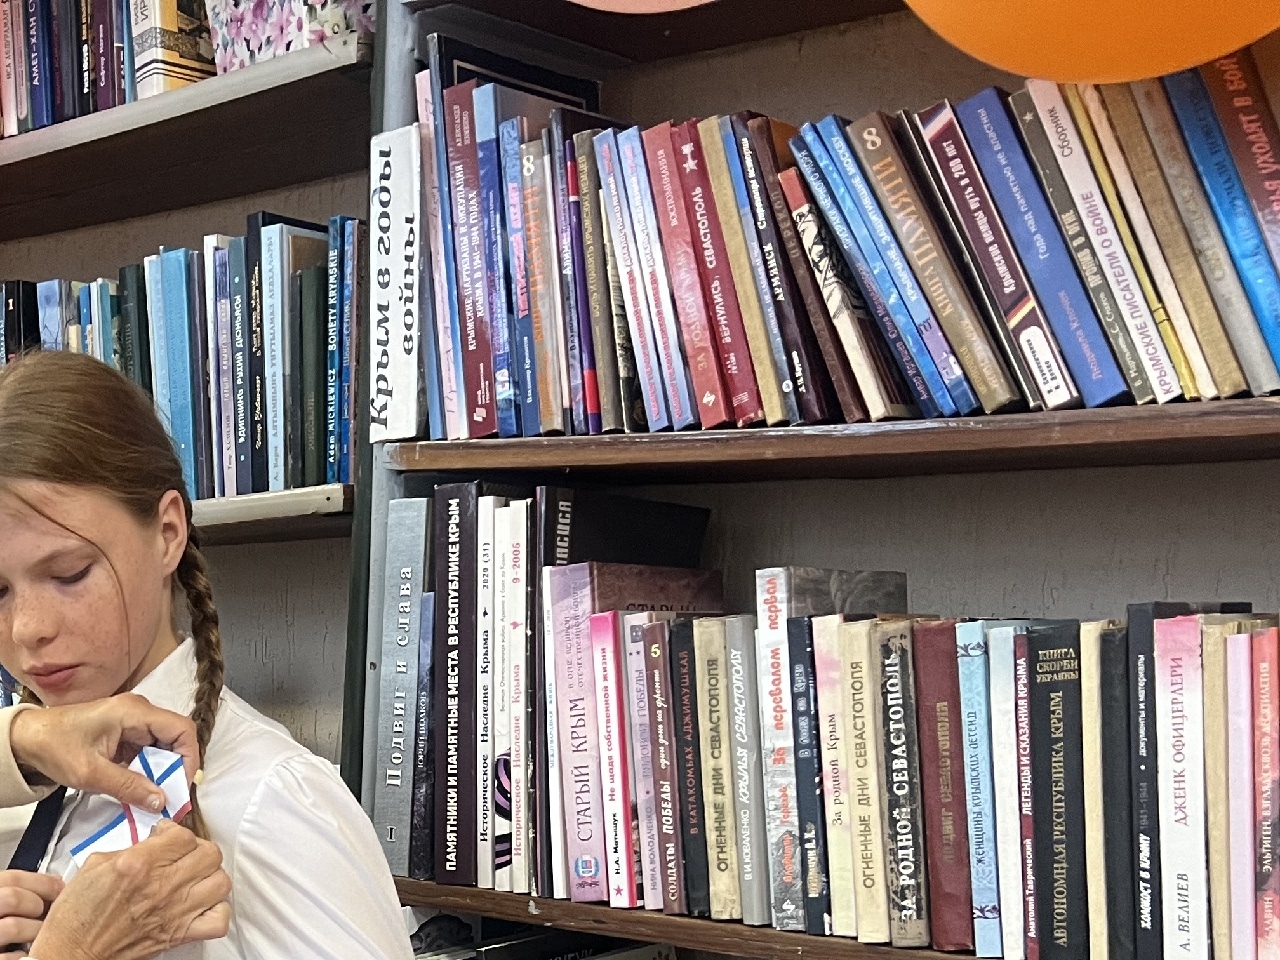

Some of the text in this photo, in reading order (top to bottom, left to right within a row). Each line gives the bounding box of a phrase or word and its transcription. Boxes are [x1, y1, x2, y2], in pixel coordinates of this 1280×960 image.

[28, 16, 40, 86] АМЕТ-ХАН
[468, 191, 479, 224] ГОДАХ
[694, 185, 716, 270] СЕВАСТОПОЛЬ
[740, 136, 785, 302] АРМЯНСК Страницы истории
[859, 125, 955, 317] КНИГА ПАМЯТИ 8
[940, 139, 959, 160] лет
[947, 156, 968, 180] 200
[961, 184, 984, 212] путь
[972, 208, 998, 244] немцы
[369, 144, 393, 430] Крым в годы
[399, 212, 417, 356] войны
[454, 164, 477, 351] КРЫМСКИЕ ПАРТИЗАНЫ И ОККУПАЦИЯ
[474, 280, 485, 317] КРЫМА
[708, 272, 733, 345] ВЕРНУЛИСЬ,
[985, 240, 1020, 295] Крымские
[1042, 105, 1177, 398] КРЫМСКИЕ ПИСАТЕЛИ О ВОЙНЕ Сборник
[327, 248, 338, 463] Adam MICKIEWICZ SONETY KRYMSKIE
[723, 352, 739, 376] МЫ
[385, 565, 413, 787] Подвиг и слава
[445, 498, 461, 871] ПАМЯТНИКИ И ПАМЯТНЫЕ МЕСТА В РЕСПУБЛИКЕ КРЫМ
[479, 541, 491, 843] Историческое Наследие Крыма 2020 (31)
[511, 542, 523, 857] Историческое Наследие Крыма 9-2005
[729, 648, 751, 805] КРЫЛЬЯ СЕВАСТОПОЛЯ
[1036, 659, 1079, 674] СКОРБИ
[1037, 647, 1076, 661] КНИГА
[568, 696, 593, 842] СТАРЫЙ КРЫМ
[678, 650, 699, 834] В КАТАКОМБАХ АДЖИМУШКАЯ
[706, 658, 730, 873] ОГНЕННЫЕ ДНИ СЕВАСТОПОЛЯ
[824, 713, 845, 826] За родной Крым
[849, 660, 877, 889] ОГНЕННЫЕ ДНИ СЕВАСТОПОЛЯ
[883, 653, 918, 921] ЗА РОДНОЙ СЕВАСТОПОЛЬ
[1015, 657, 1037, 938] Анатолий Таврический ЛЕГЕНДЫ И СКАЗАНИЯ КРЫМА
[1048, 691, 1069, 947] АВТОНОМНАЯ РЕСПУБЛИКА КРЫМ
[1170, 656, 1192, 952] А. ВЕЛИЕВ ДЖЕНК ОФИЦЕРЛЕРИ
